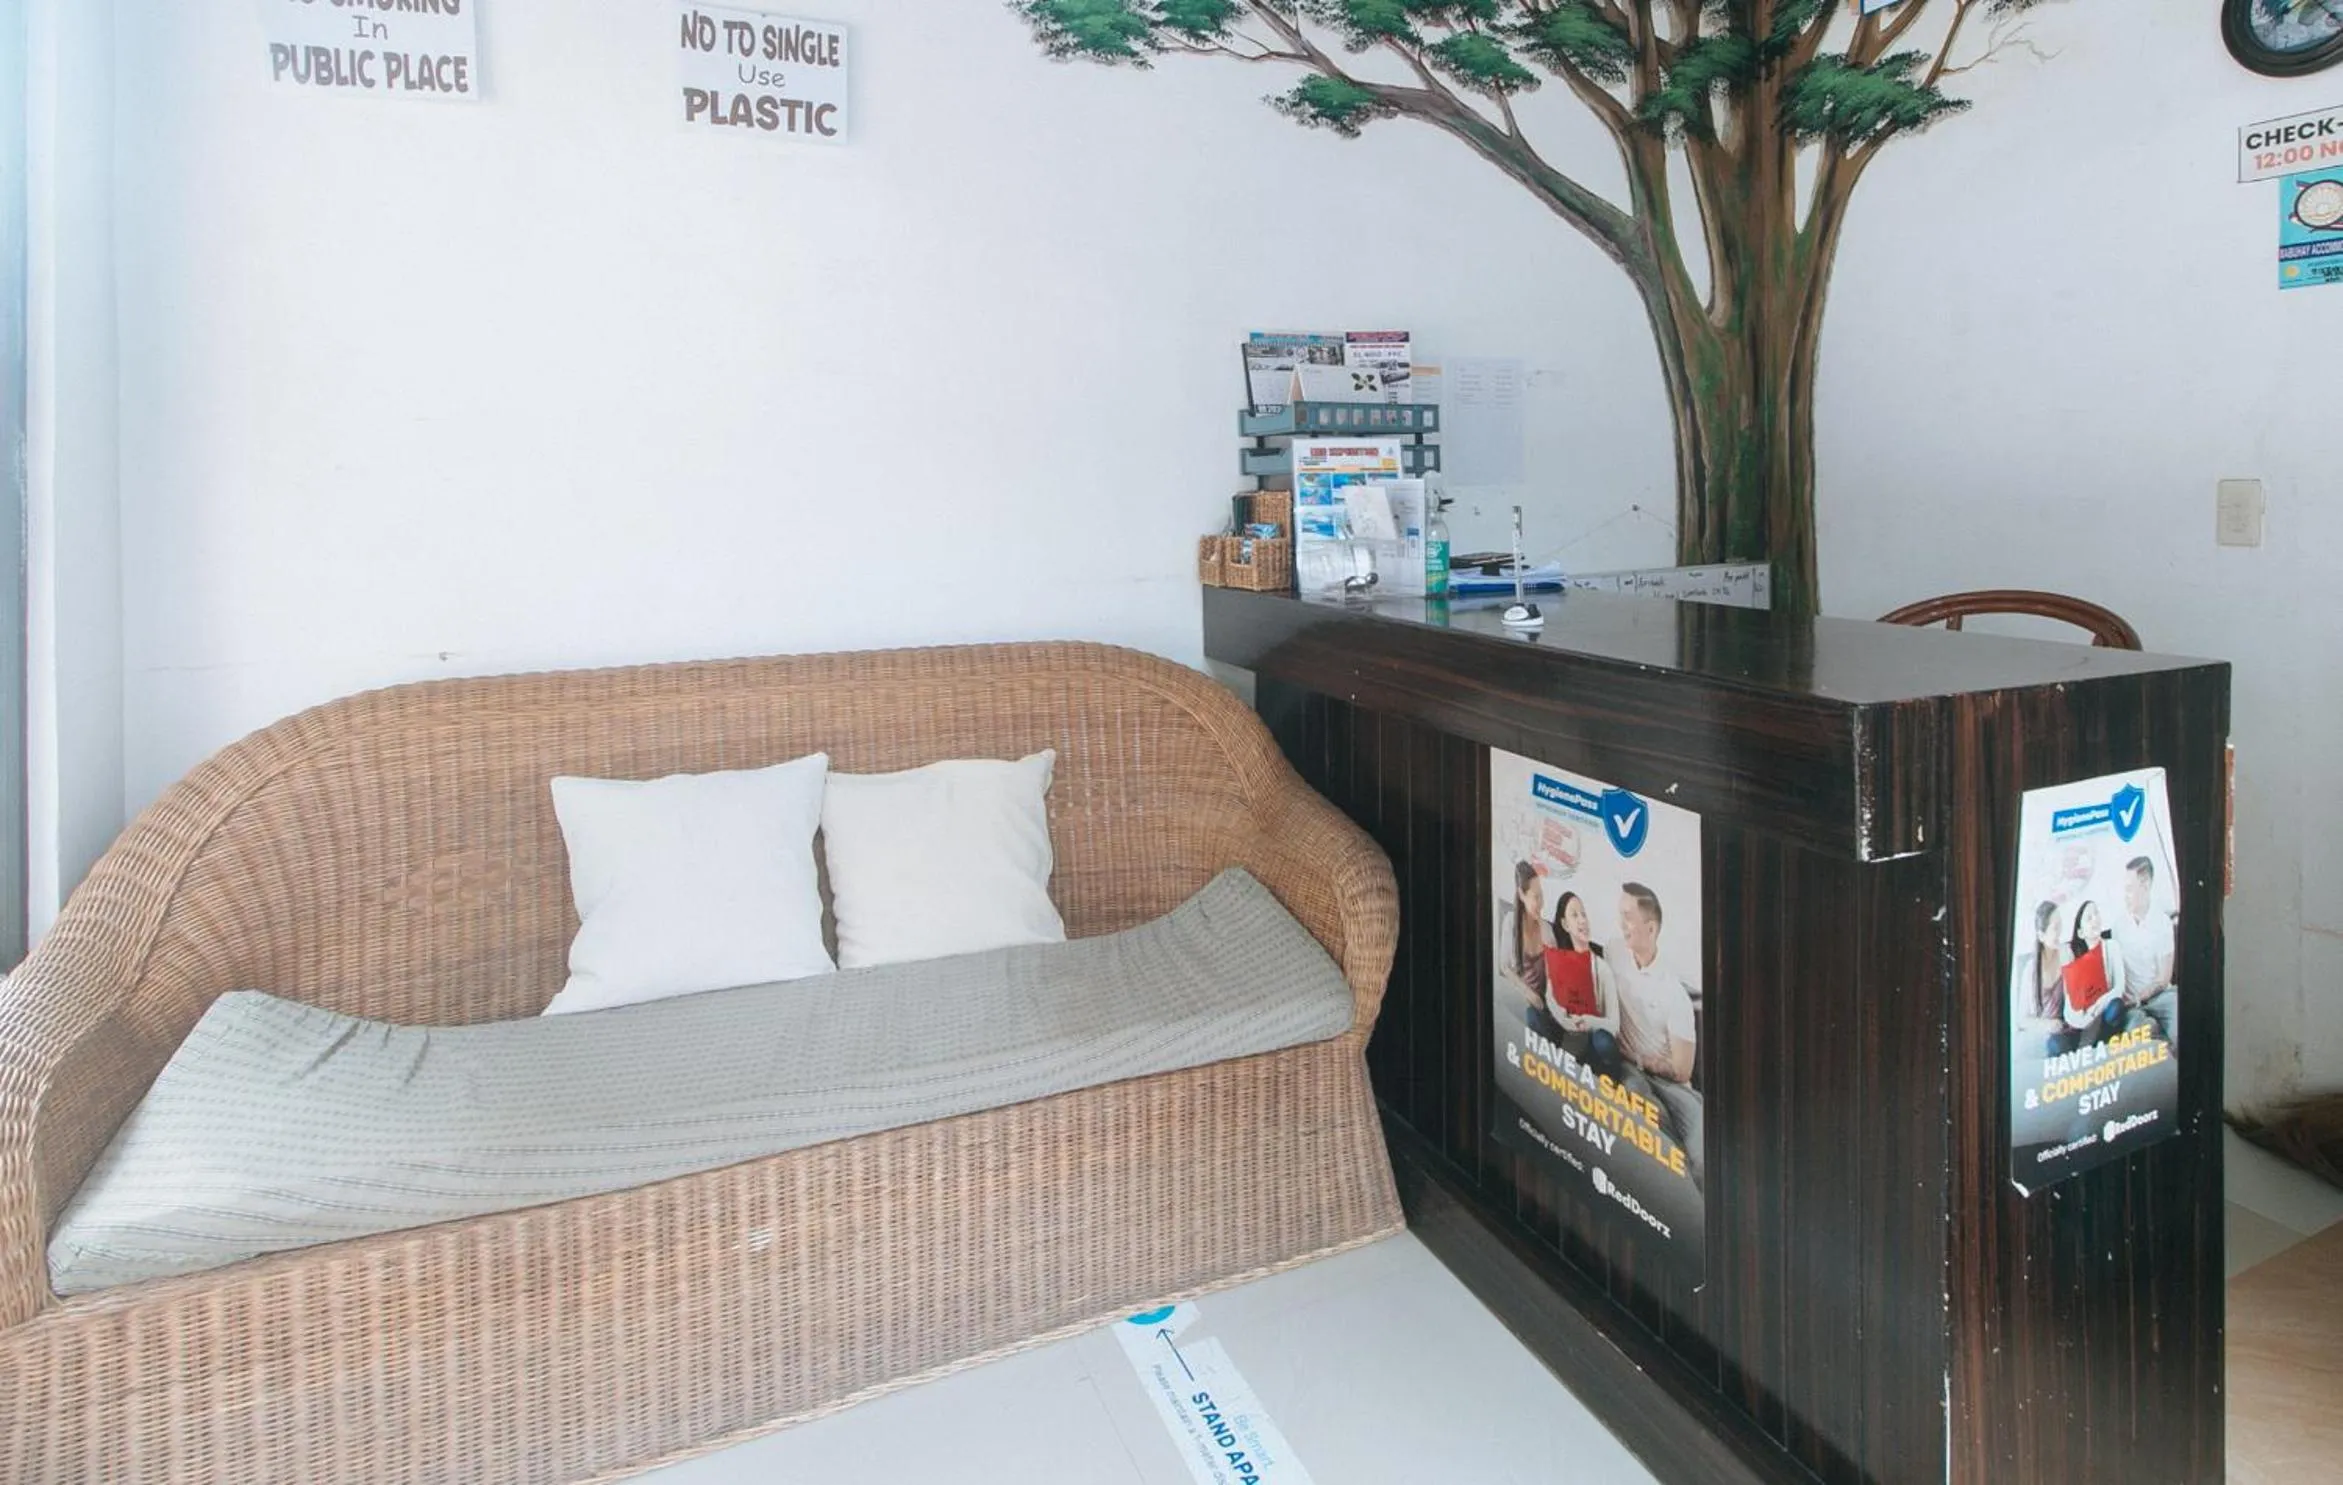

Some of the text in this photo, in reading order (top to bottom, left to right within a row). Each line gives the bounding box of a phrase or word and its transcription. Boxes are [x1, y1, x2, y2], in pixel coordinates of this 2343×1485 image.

[352, 15, 388, 39] In
[681, 10, 840, 67] NO TO SINGLE
[270, 43, 469, 93] PUBLIC PLACE
[738, 63, 786, 87] Use
[682, 87, 838, 137] PLASTIC
[2253, 140, 2343, 170] 12:00 N
[1537, 781, 1598, 811] HygienePass
[2024, 1042, 2169, 1110] & COMFORTABLE
[2044, 1024, 2152, 1078] HAVE A SAFE
[1524, 1027, 1660, 1129] HAVE A SAFE
[2079, 1081, 2121, 1115] STAY
[1506, 1041, 1687, 1178] & COMFORTABLE
[1562, 1103, 1616, 1156] STAY
[1607, 1180, 1672, 1239] RedDoorz
[1192, 1391, 1260, 1485] STAND APA
